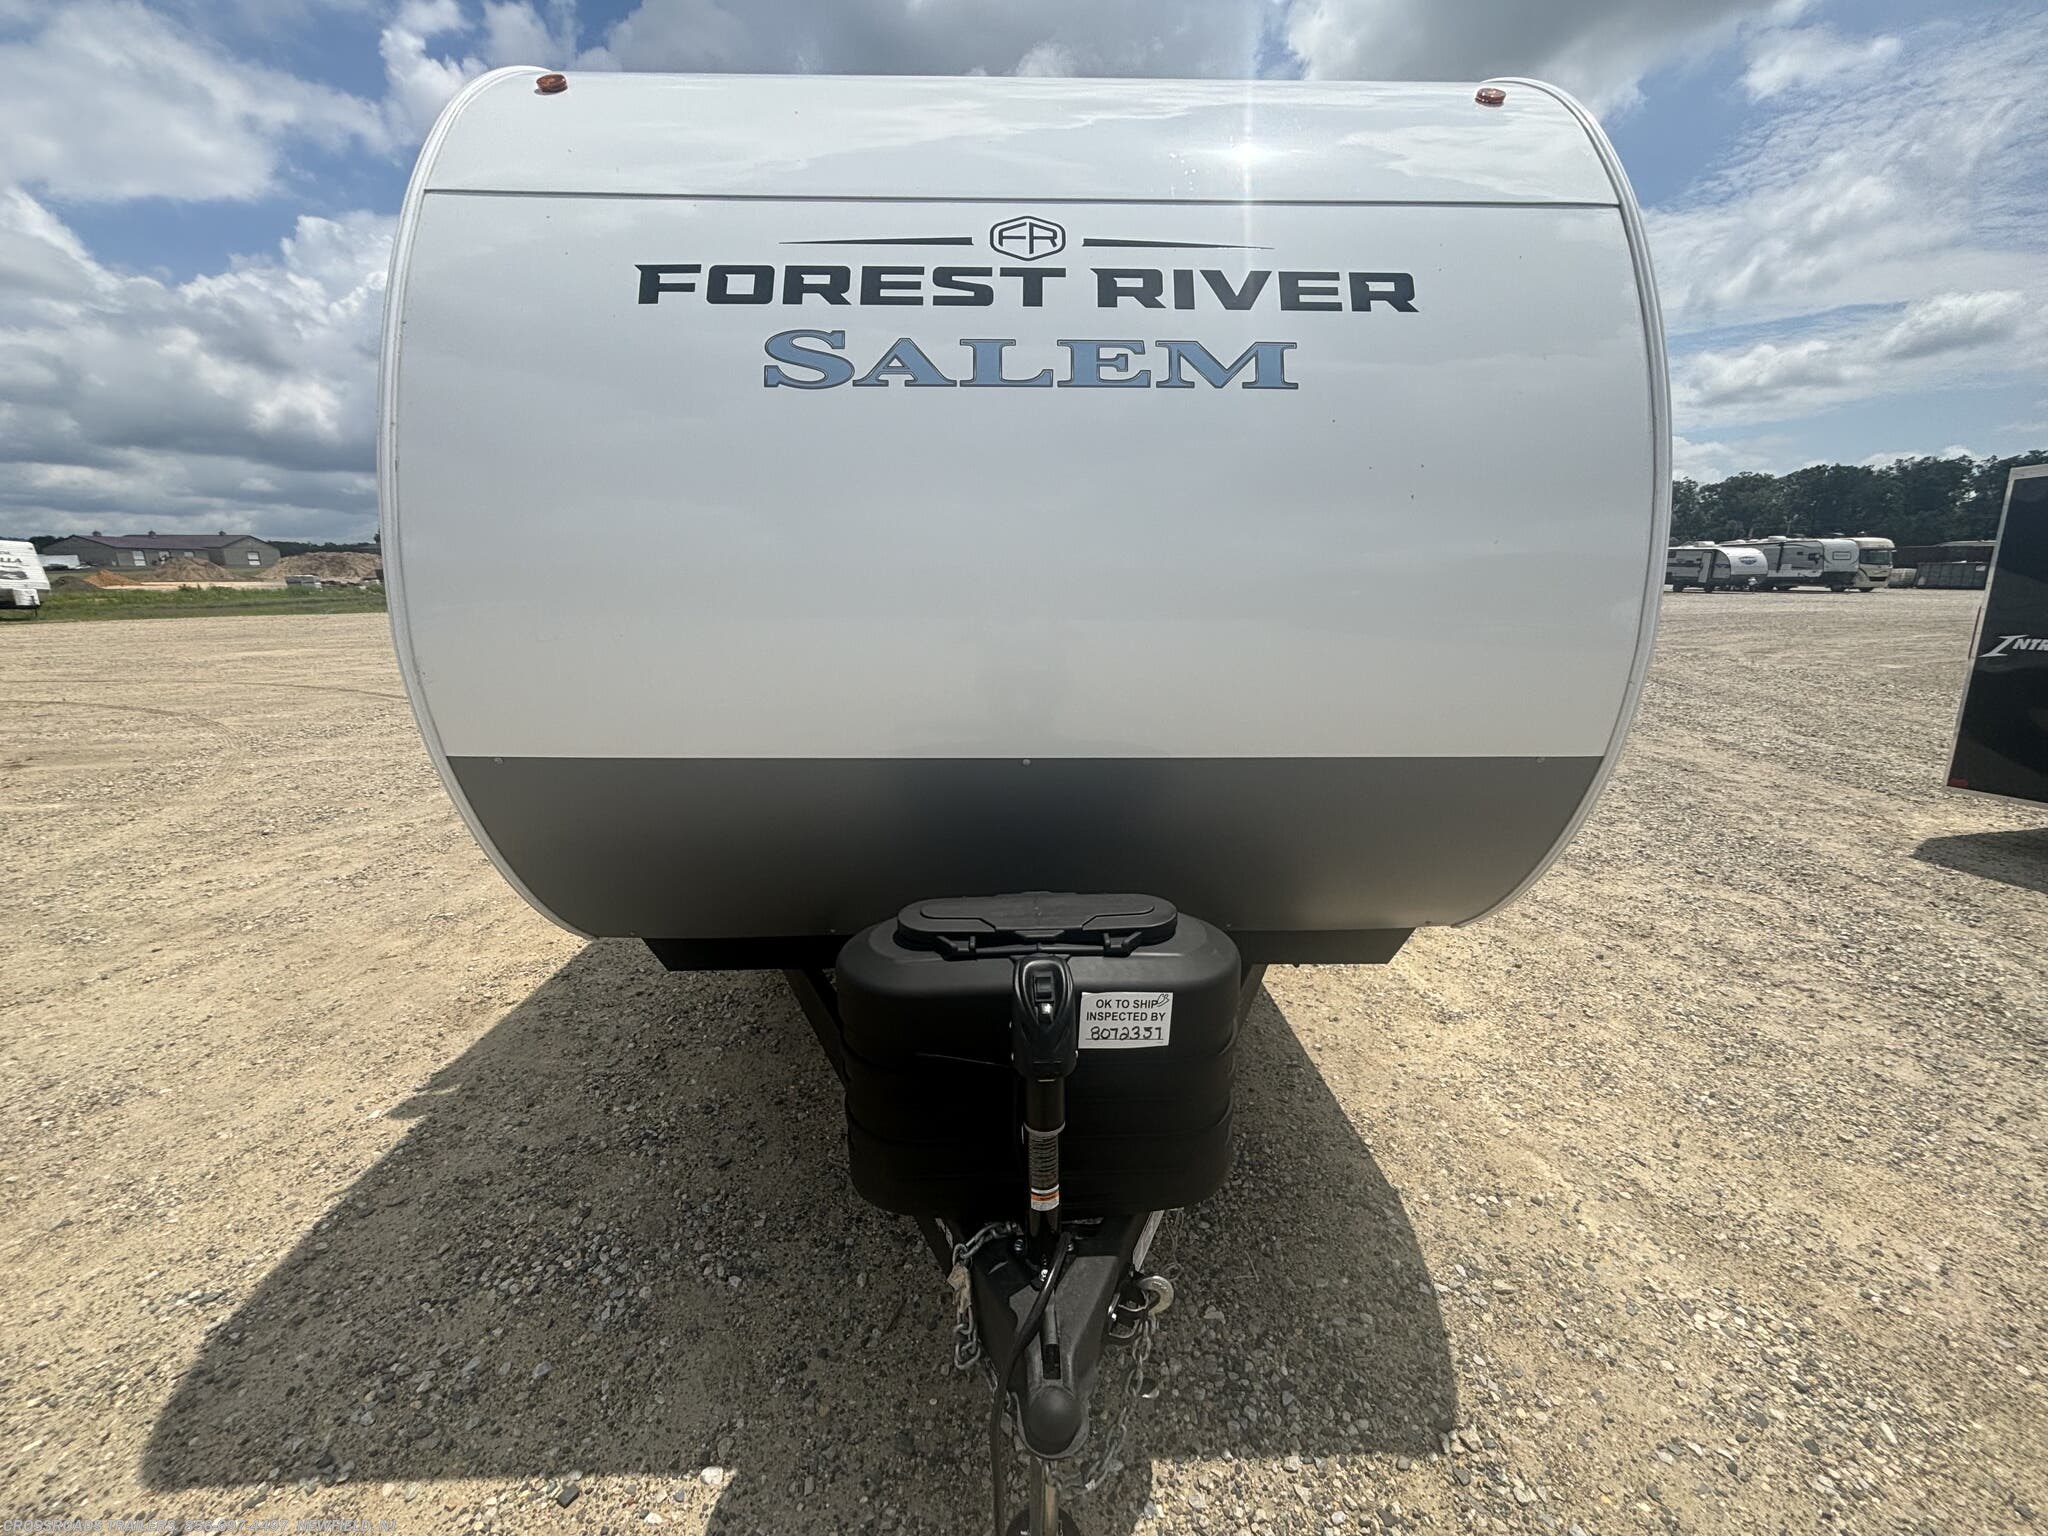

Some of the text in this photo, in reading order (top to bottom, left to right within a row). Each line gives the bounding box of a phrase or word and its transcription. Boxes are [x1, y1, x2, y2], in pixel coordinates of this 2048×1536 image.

[635, 264, 1419, 312] FOREST RIVER
[764, 329, 1299, 390] SALEM
[1086, 1012, 1166, 1021] INSPECTED BY
[1096, 999, 1112, 1008] OK
[1115, 999, 1130, 1008] TO
[1132, 999, 1158, 1009] SHIP
